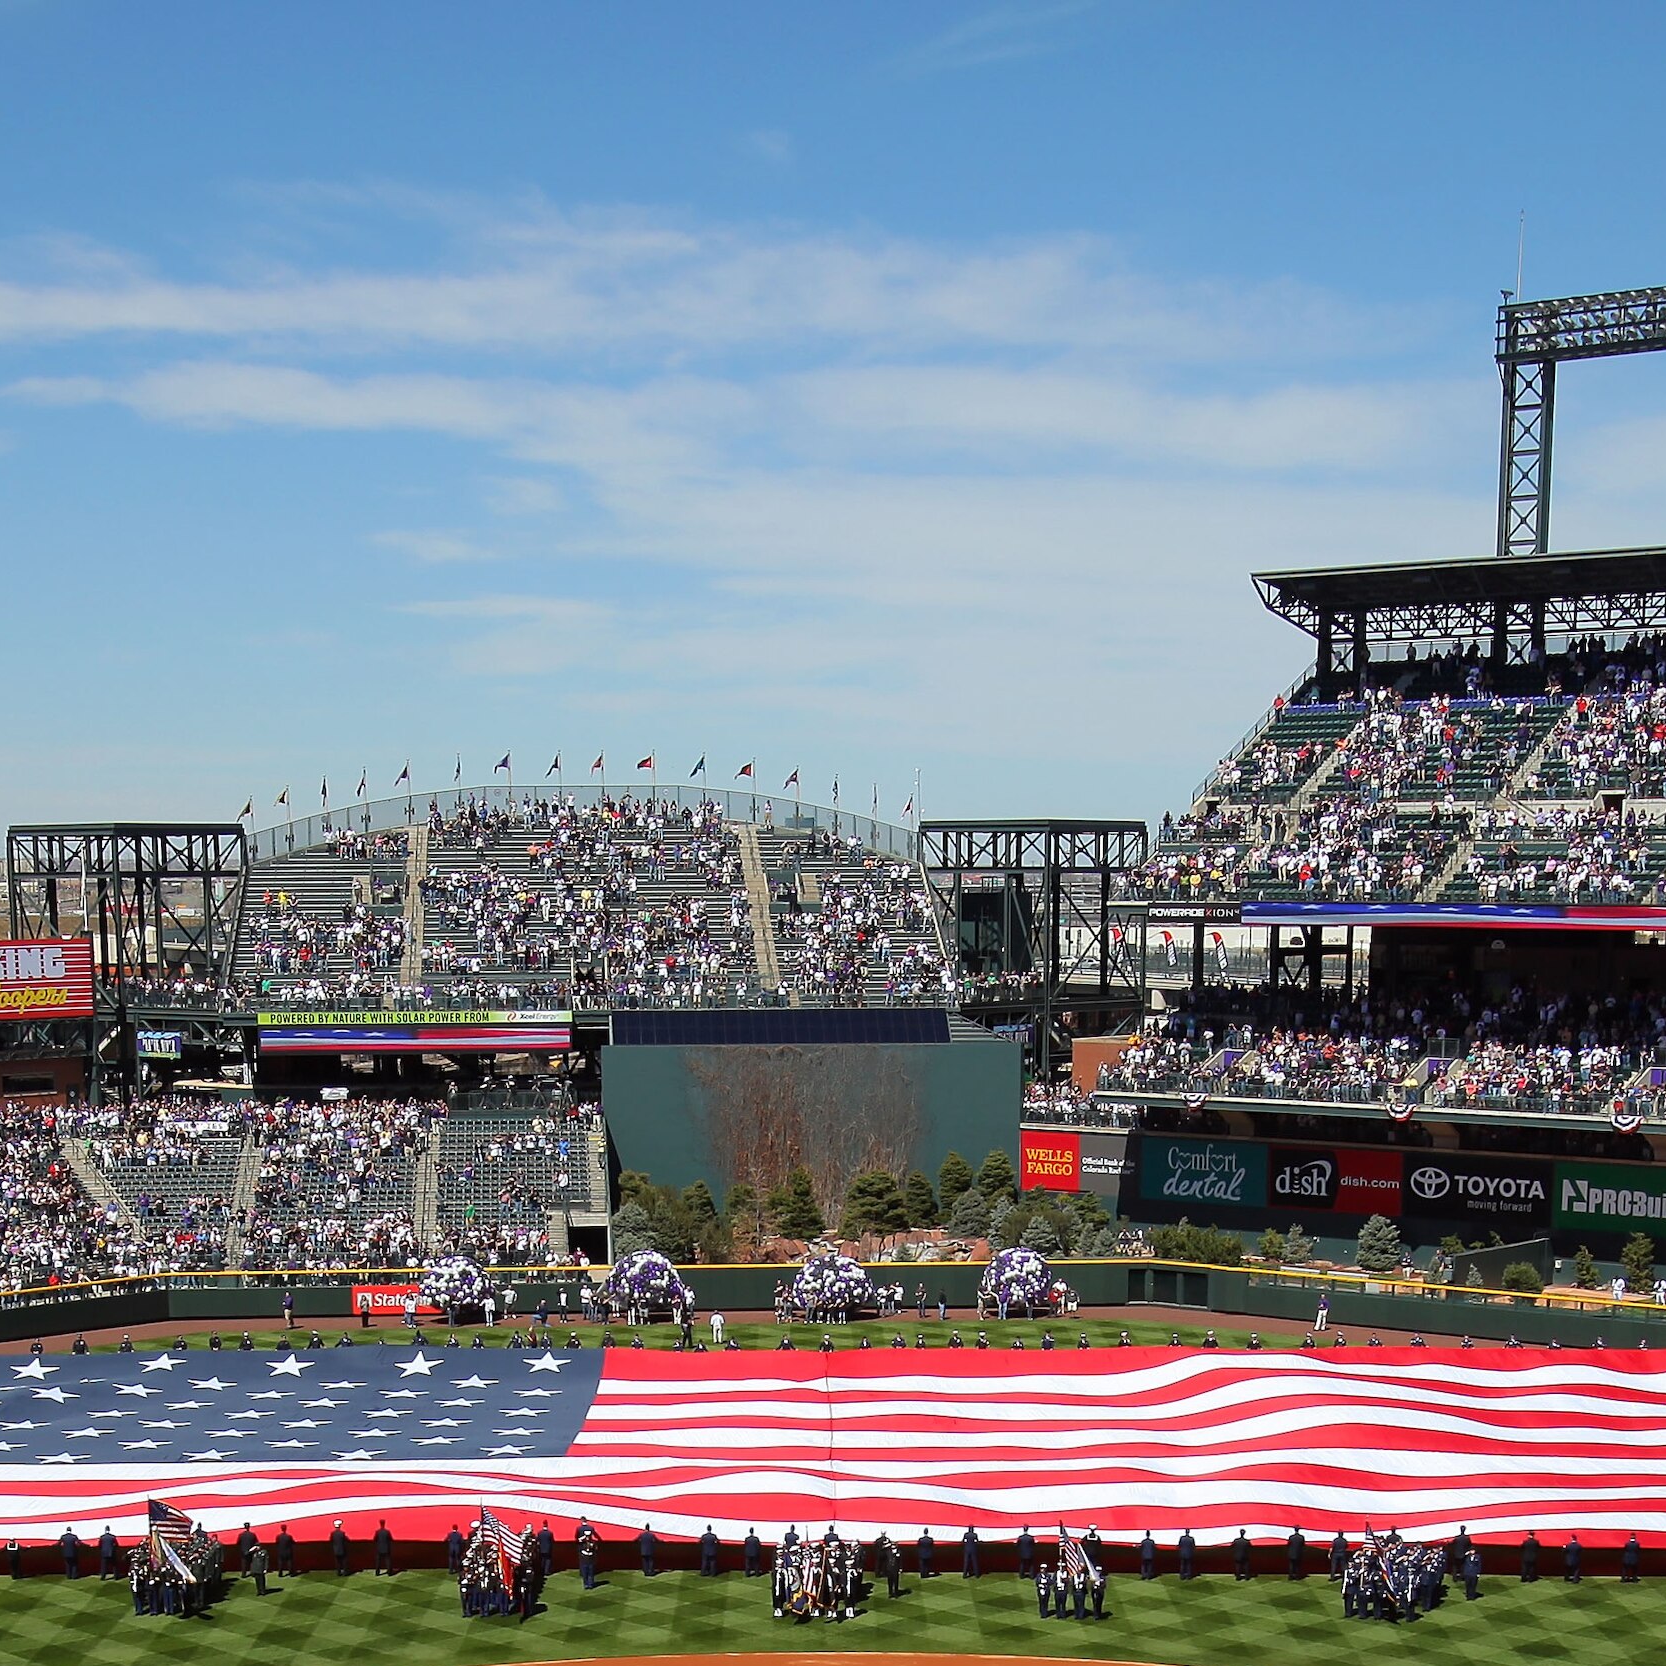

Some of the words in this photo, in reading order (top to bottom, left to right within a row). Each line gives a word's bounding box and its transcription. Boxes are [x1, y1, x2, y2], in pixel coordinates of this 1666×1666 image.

[1149, 908, 1205, 917] POWERADE
[270, 1012, 315, 1024] POWERED
[318, 1012, 330, 1024] BY
[333, 1012, 367, 1024] NATURE
[370, 1012, 394, 1024] WITH
[396, 1012, 426, 1024] SOLAR
[428, 1012, 461, 1024] POWER
[464, 1011, 490, 1023] FROM
[1025, 1149, 1073, 1162] WELLS
[1168, 1144, 1238, 1172] Comfort
[1027, 1162, 1073, 1175] FARGO
[1163, 1168, 1246, 1201] dental
[1275, 1160, 1332, 1196] dish
[1340, 1176, 1400, 1189] dish.com
[1454, 1175, 1545, 1199] TOYOTA
[1467, 1199, 1497, 1212] moving
[1500, 1200, 1532, 1213] forward
